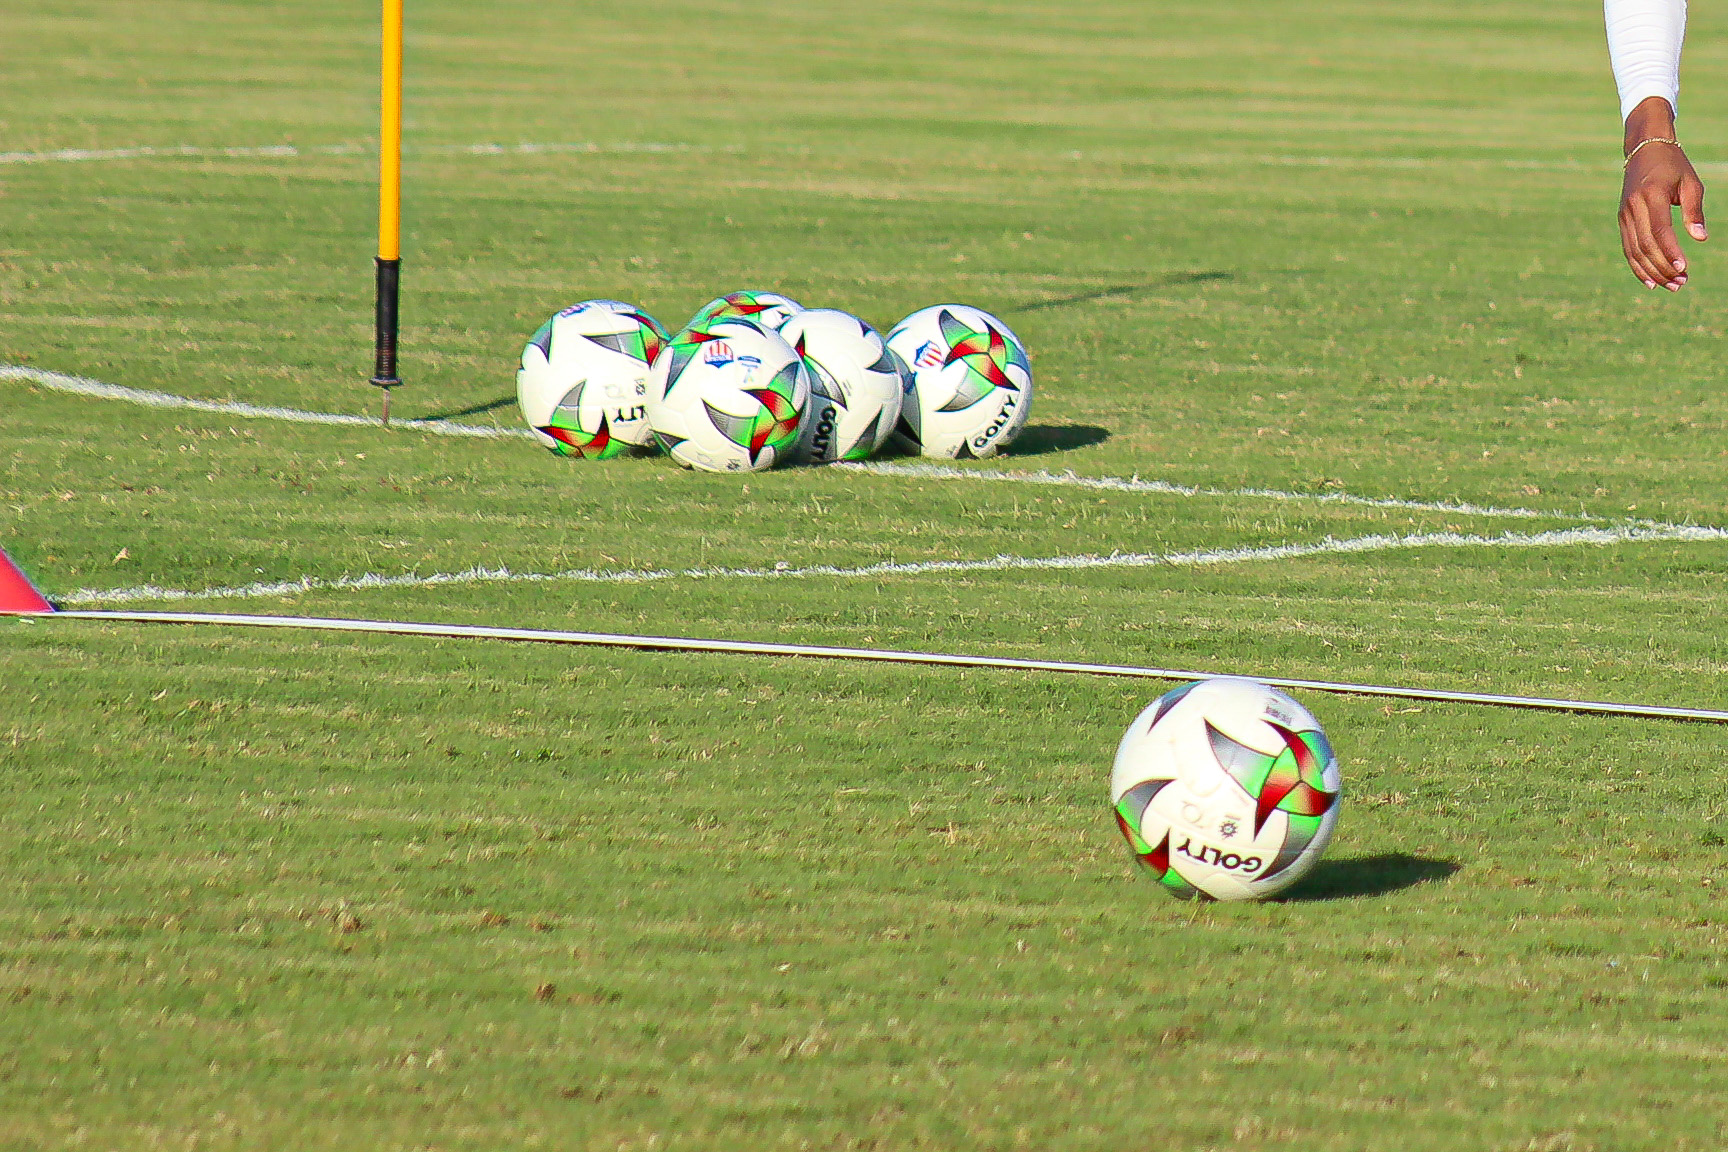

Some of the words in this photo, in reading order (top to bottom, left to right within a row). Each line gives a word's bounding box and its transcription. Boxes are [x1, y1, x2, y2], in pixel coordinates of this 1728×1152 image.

[612, 404, 645, 427] LTY
[811, 408, 837, 459] GOLTY
[974, 394, 1016, 448] GOLTY
[1177, 838, 1262, 872] GOLTY
